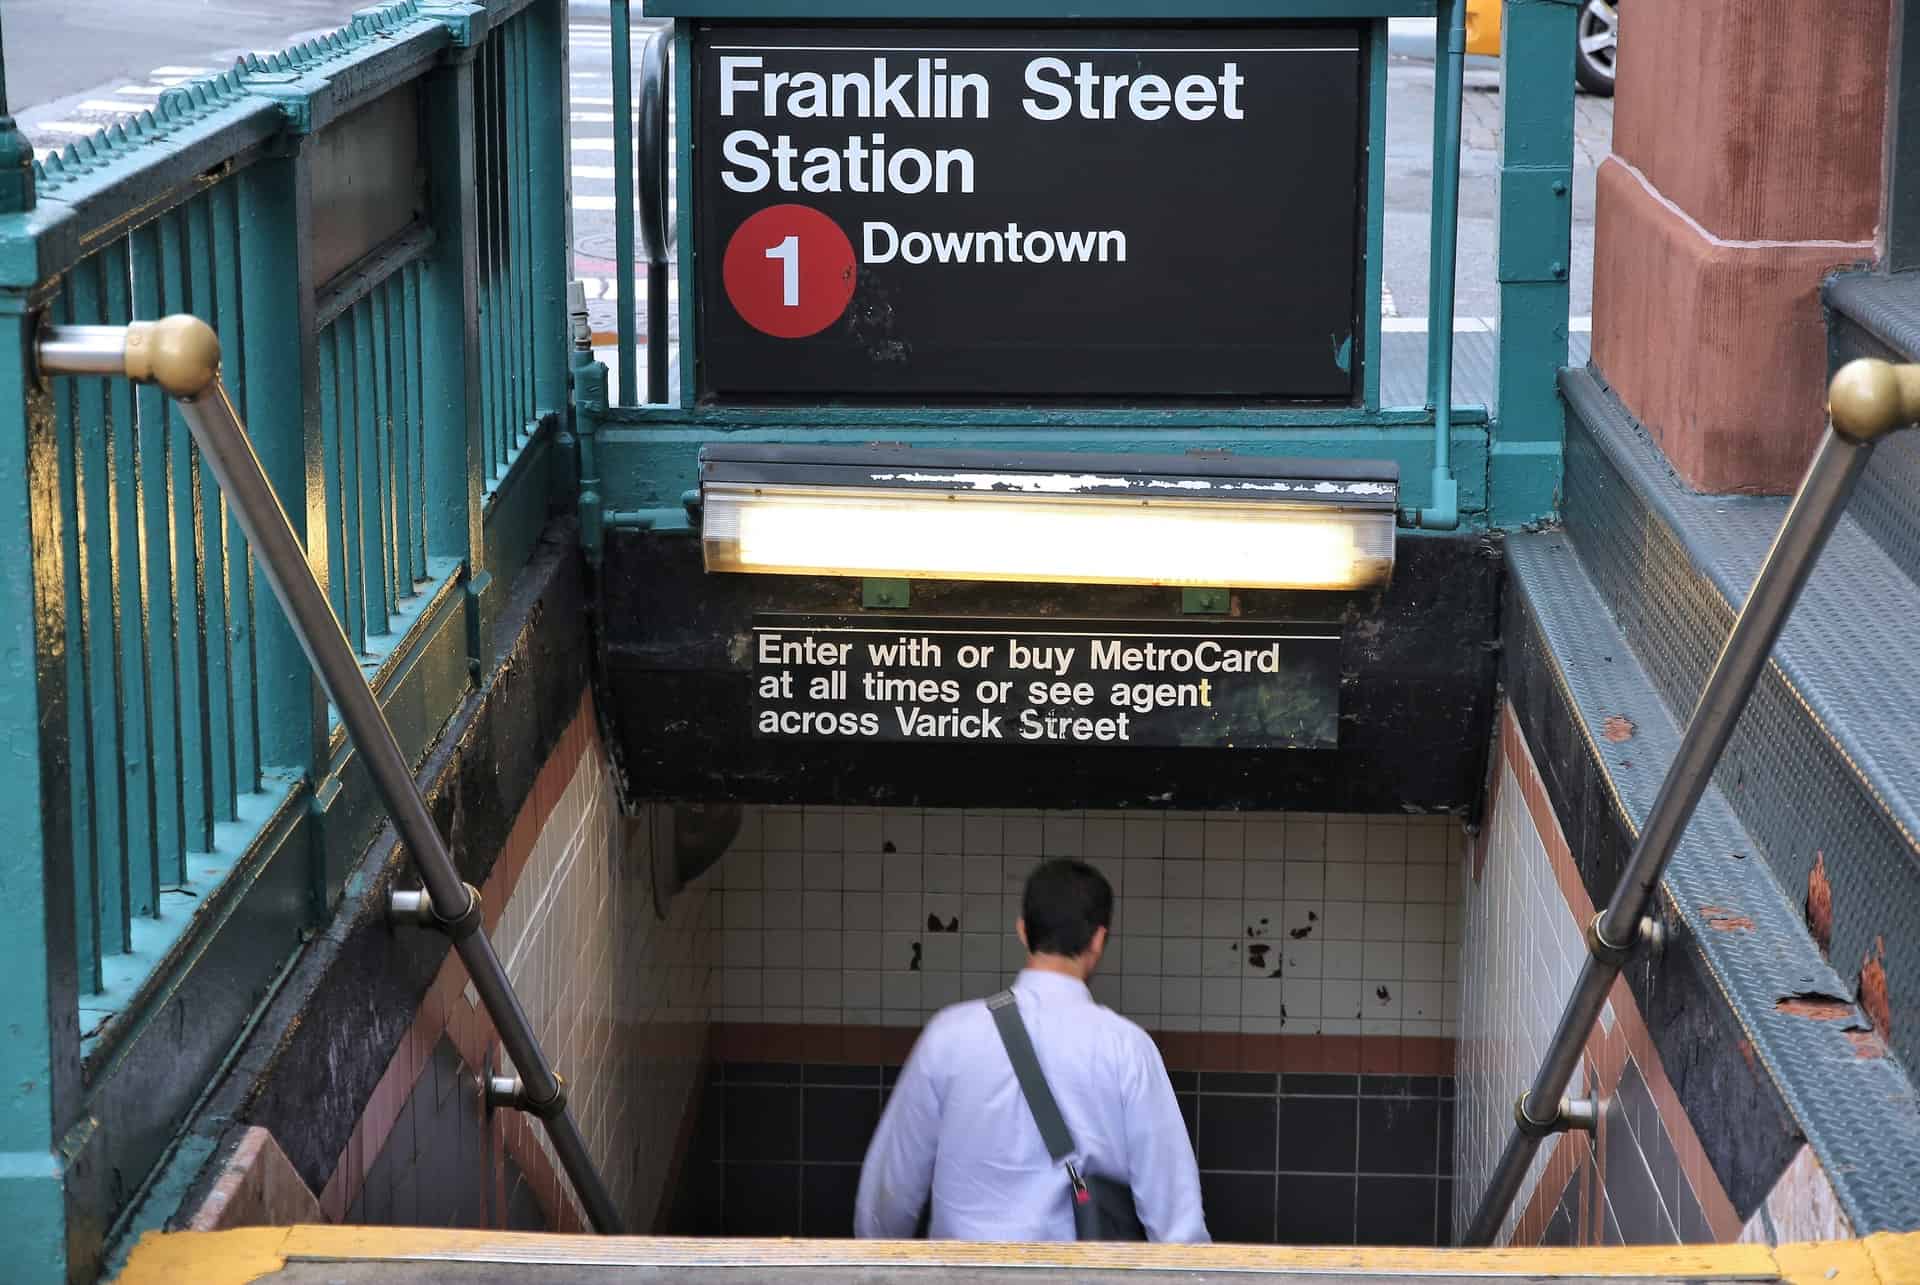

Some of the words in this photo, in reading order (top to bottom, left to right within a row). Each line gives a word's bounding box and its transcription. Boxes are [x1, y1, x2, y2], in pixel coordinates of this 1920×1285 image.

[719, 55, 990, 119] Franklin
[1022, 56, 1245, 121] Street
[721, 129, 974, 194] Station
[765, 236, 799, 306] 1
[863, 221, 1126, 265] Downtown
[758, 633, 853, 666] Enter
[867, 636, 942, 667] with
[956, 645, 995, 669] or
[1009, 638, 1076, 676] buy
[1090, 639, 1280, 673] MetroCard
[758, 670, 793, 699] at
[809, 670, 847, 700] all
[862, 672, 961, 703] times
[976, 680, 1014, 704] or
[1027, 681, 1095, 706] see
[1110, 678, 1212, 714] agent
[758, 710, 880, 737] across
[894, 706, 1003, 739] Varick
[1018, 708, 1130, 741] Street
